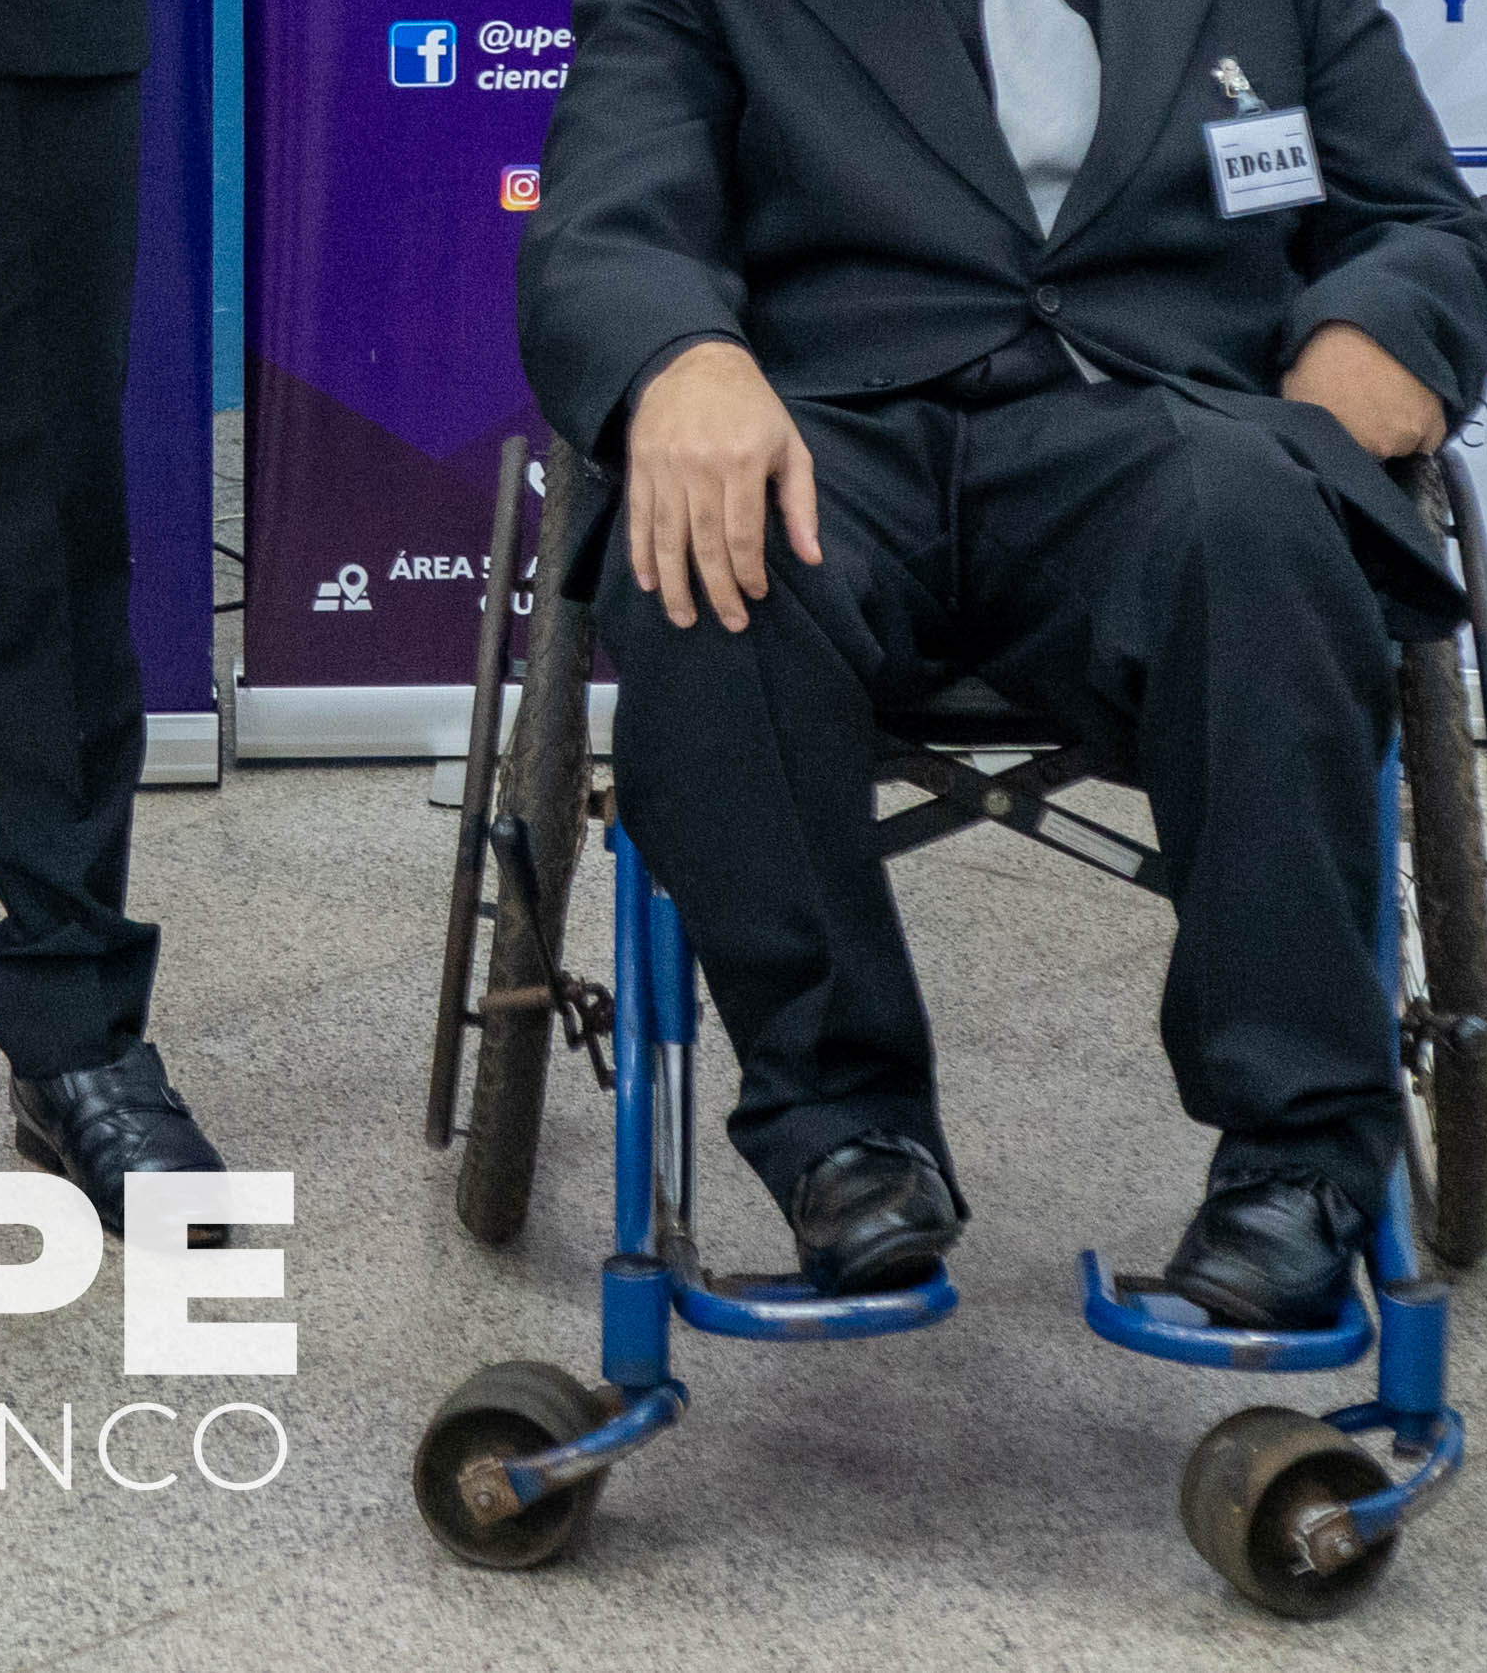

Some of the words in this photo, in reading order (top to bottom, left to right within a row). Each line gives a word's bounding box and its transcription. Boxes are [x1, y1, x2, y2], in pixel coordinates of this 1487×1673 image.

[478, 63, 568, 90] cienci
[1225, 147, 1308, 179] EDGAR
[389, 551, 474, 580] ÁREA
